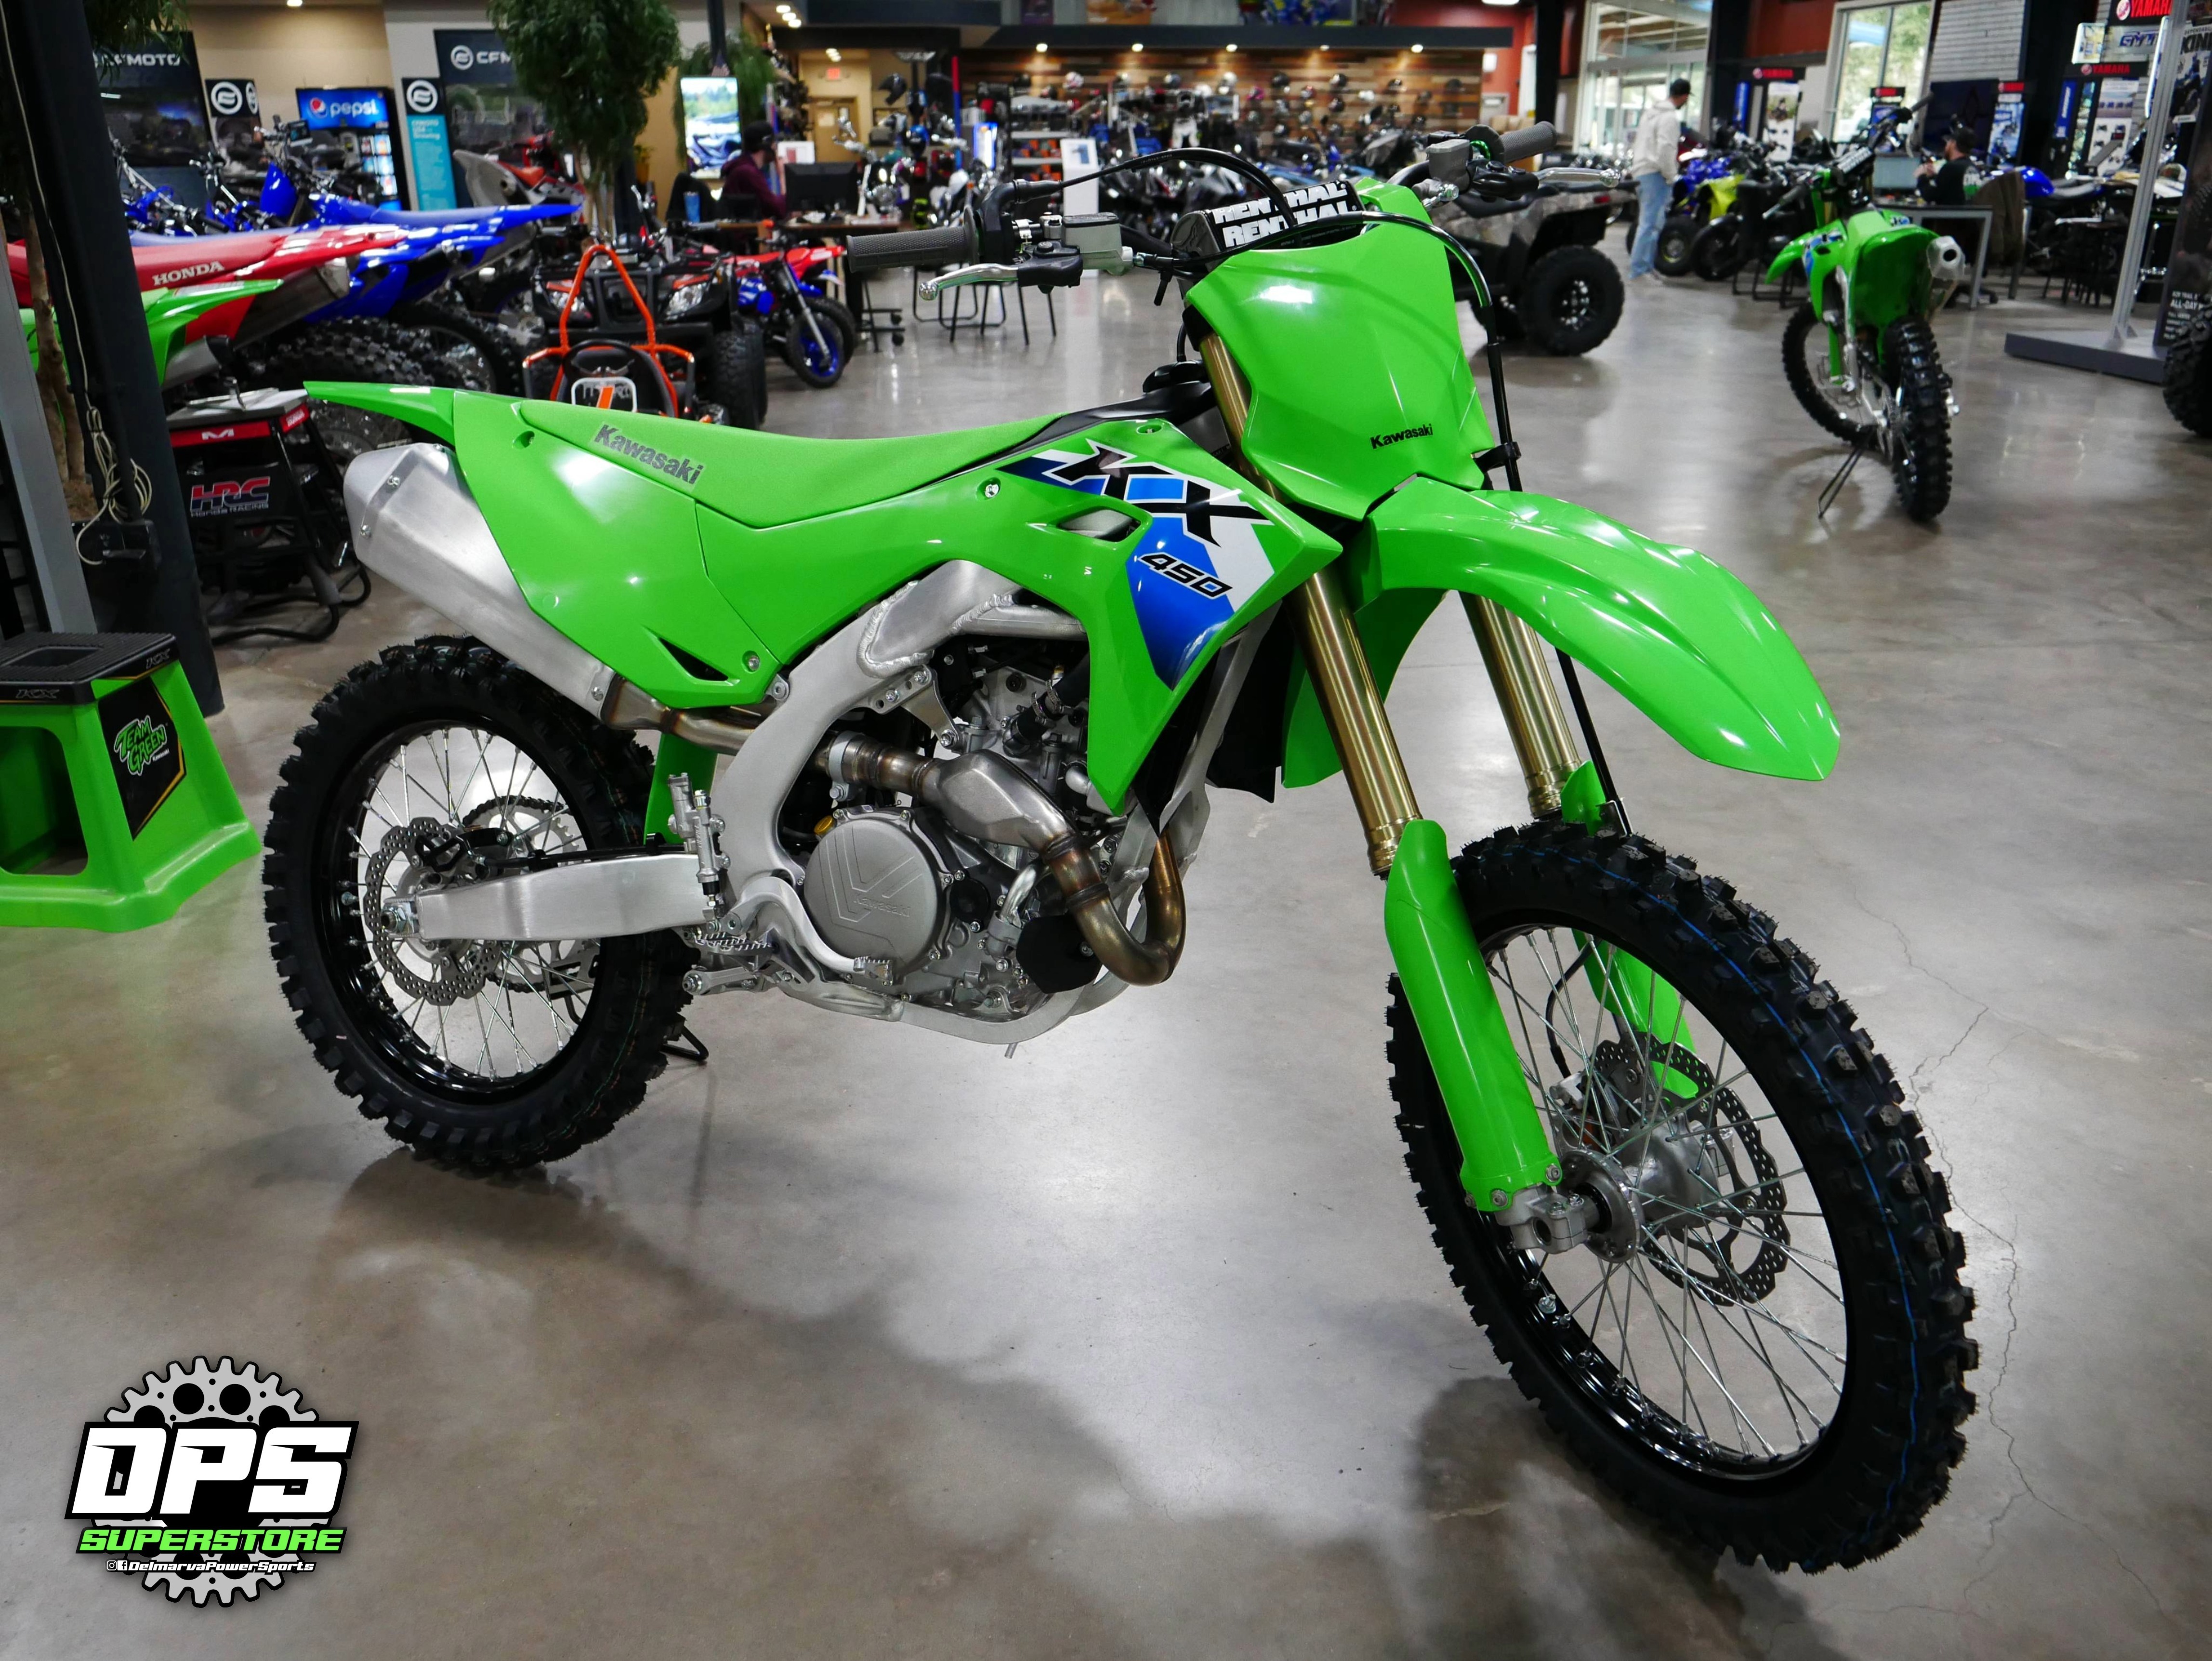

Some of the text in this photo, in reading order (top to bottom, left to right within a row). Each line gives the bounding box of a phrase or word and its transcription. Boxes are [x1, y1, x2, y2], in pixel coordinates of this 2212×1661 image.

[330, 99, 379, 118] pepsi
[152, 261, 224, 285] HONDA
[594, 424, 704, 485] Kawasaki
[1370, 423, 1433, 450] Kawasaki
[190, 476, 270, 512] HRC
[1137, 552, 1233, 599] 450
[115, 716, 151, 761] TEAM
[128, 725, 166, 775] GREEN
[853, 893, 911, 918] Kawasaki
